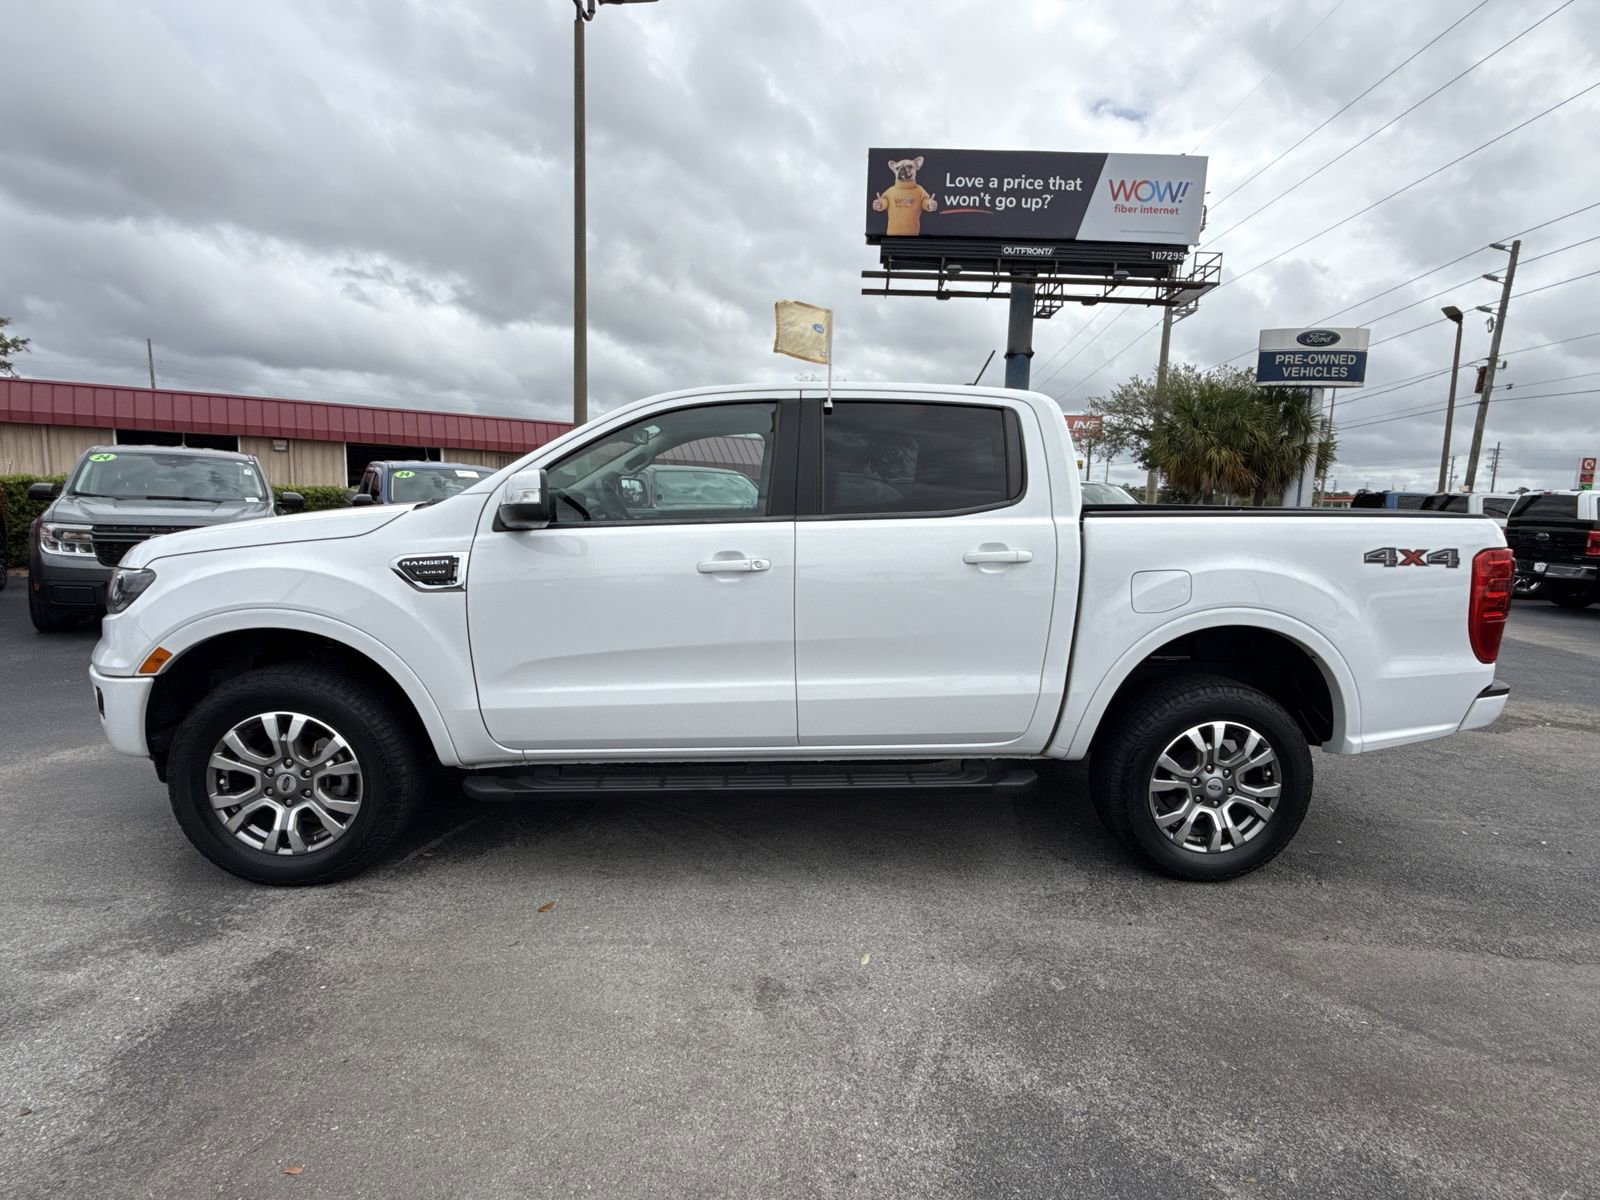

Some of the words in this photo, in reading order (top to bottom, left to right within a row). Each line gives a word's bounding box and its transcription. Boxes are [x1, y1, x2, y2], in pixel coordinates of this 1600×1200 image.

[945, 173, 984, 188] Love
[989, 176, 998, 188] a
[1003, 174, 1044, 192] price
[1048, 176, 1083, 191] that
[1108, 179, 1190, 204] WOW!
[944, 192, 992, 207] won't
[995, 197, 1017, 211] go
[1114, 204, 1138, 214] fiber
[1140, 206, 1179, 215] internet
[1306, 332, 1333, 343] Ford
[1275, 354, 1357, 365] PRE-OWNED
[1282, 367, 1349, 378] VEHICLES
